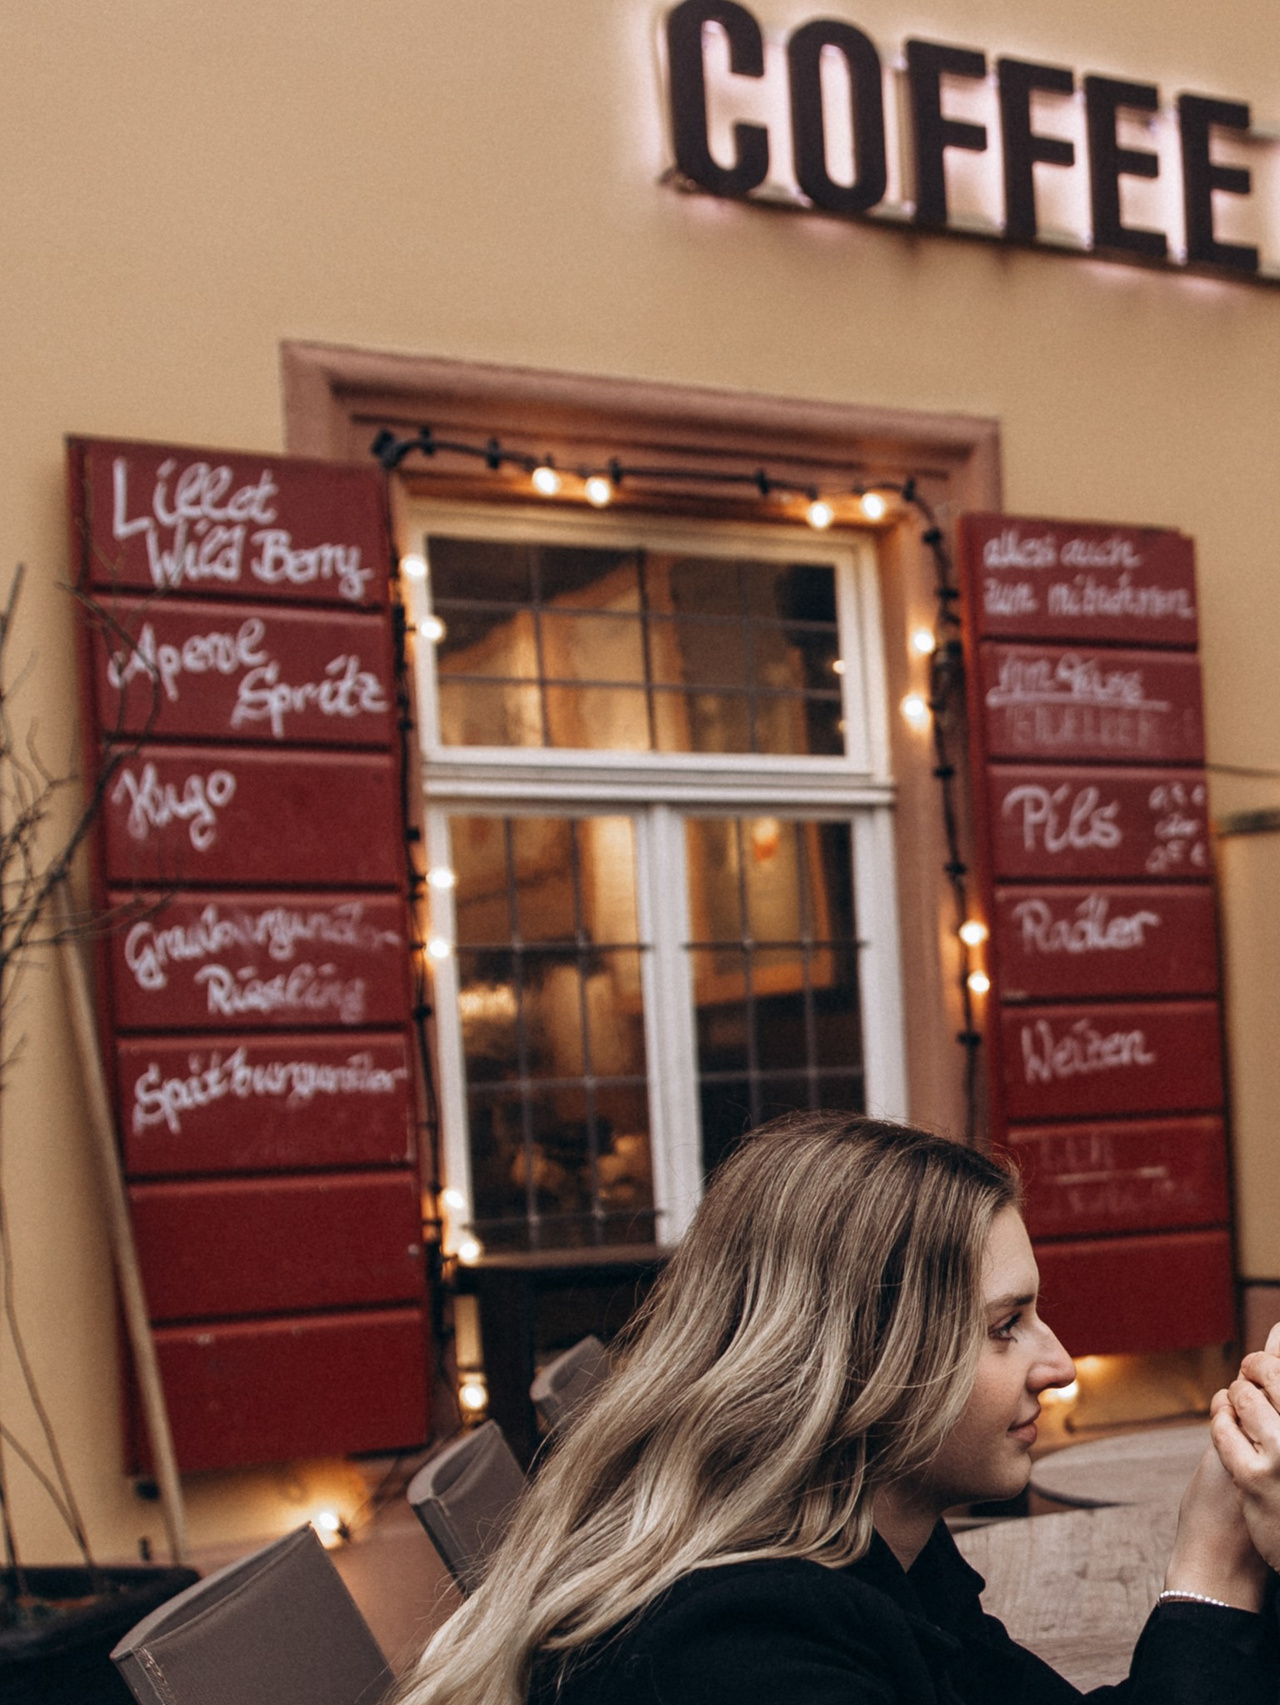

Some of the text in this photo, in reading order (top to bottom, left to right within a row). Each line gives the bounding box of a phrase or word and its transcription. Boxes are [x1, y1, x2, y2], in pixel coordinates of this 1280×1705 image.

[664, 0, 1262, 270] COFFEE
[112, 456, 278, 540] Lillet
[146, 518, 246, 588] Wild
[107, 617, 270, 701] Aperol
[111, 762, 236, 852] Hugo
[1002, 783, 1122, 852] Pils
[1012, 894, 1162, 955] Radler
[1021, 1018, 1155, 1083] Weizen
